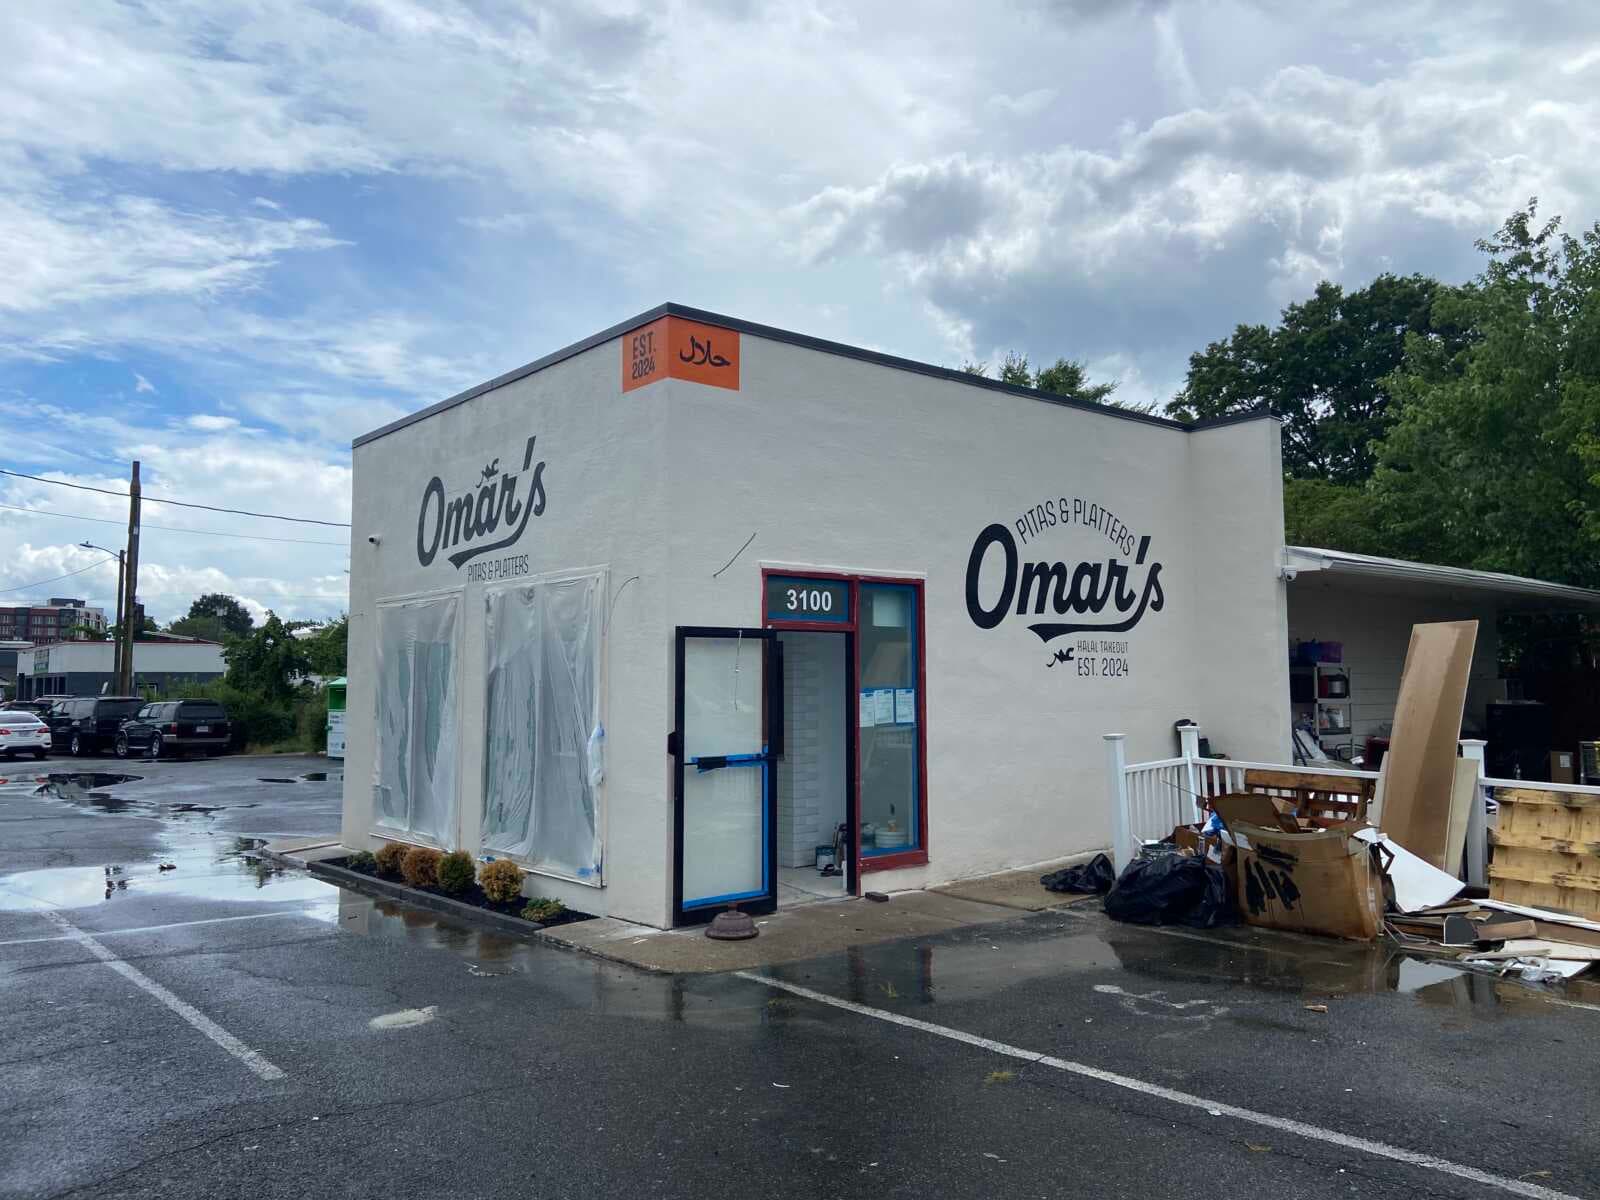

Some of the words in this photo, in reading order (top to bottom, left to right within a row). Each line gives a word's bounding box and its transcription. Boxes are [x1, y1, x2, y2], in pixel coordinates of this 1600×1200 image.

[632, 331, 657, 361] EST.
[680, 335, 731, 368] حلال
[632, 356, 656, 380] 2024
[416, 436, 547, 570] Omar's
[1015, 500, 1057, 545] PITAS
[1059, 497, 1070, 524] &
[1073, 498, 1136, 557] PLATTERS
[467, 562, 487, 584] PITAS
[488, 560, 493, 580] &
[494, 554, 529, 579] PLATTERS
[965, 523, 1165, 643] Omar's
[786, 588, 832, 612] 3100
[1077, 639, 1098, 654] HALAL
[1100, 640, 1129, 654] TAKEOUT
[1077, 657, 1098, 677] EST.
[1102, 657, 1129, 677] 2024
